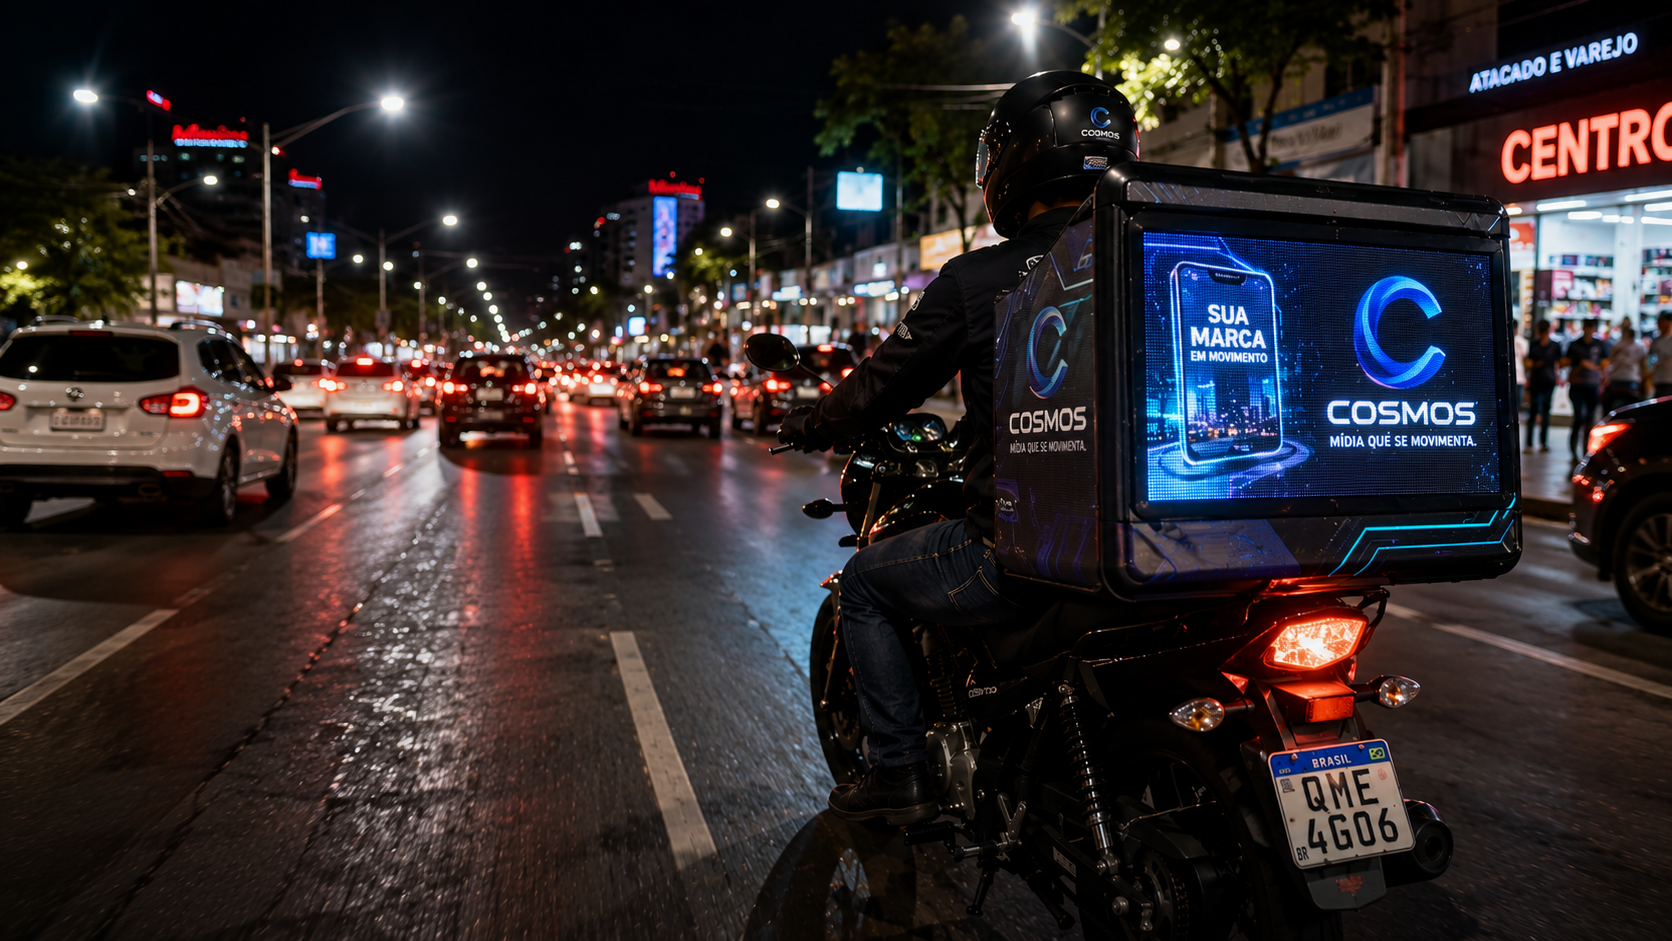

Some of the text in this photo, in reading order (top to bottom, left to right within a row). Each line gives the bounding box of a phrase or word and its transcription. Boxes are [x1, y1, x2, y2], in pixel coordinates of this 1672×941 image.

[1469, 32, 1638, 94] ATACADO E VAREJO
[1501, 101, 1672, 184] CENTRO
[1207, 304, 1249, 325] SUA
[1190, 326, 1267, 349] MARCA
[1190, 350, 1268, 363] EM MOVIMENTO
[1009, 406, 1087, 434] COSMOS
[1326, 400, 1476, 426] COSMOS
[1010, 440, 1087, 454] MÍDIA QUE SE MOVIMENTA.
[1329, 432, 1365, 448] MÍDIA
[1394, 435, 1408, 447] SE
[1411, 435, 1478, 447] MOVIMENTA.
[1312, 754, 1351, 768] BRASIL
[1301, 768, 1379, 814] QME
[1307, 807, 1399, 854] 4G06
[1296, 846, 1309, 861] BR
